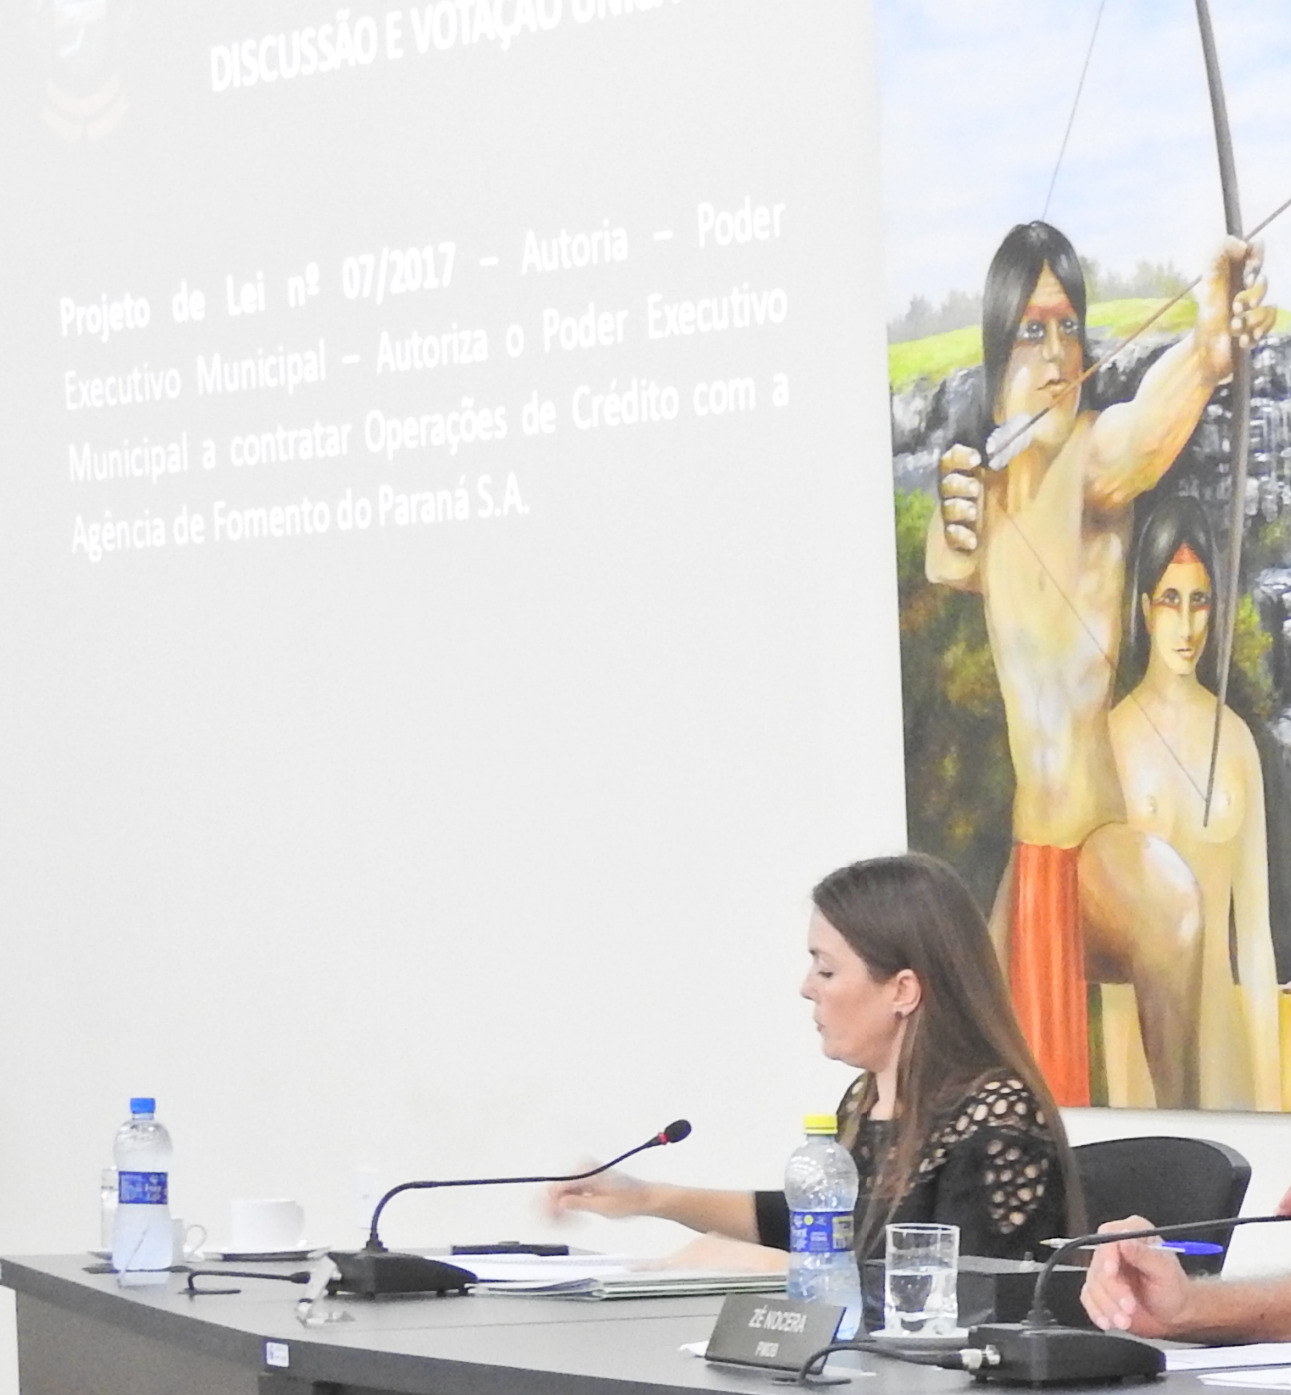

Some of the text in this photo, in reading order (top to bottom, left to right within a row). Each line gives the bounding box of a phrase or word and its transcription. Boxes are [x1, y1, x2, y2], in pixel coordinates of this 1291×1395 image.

[210, 8, 379, 93] DISCUSSÃO
[385, 10, 404, 61] E
[59, 292, 151, 343] Projeto
[171, 280, 206, 323] de
[226, 270, 266, 316] Lei
[341, 241, 457, 306] 07/2017
[521, 218, 629, 275] Autoria
[697, 195, 786, 249] Poder
[64, 362, 182, 411] Executivo
[196, 338, 327, 395] Municipal
[376, 321, 489, 374] Autoriza
[505, 323, 525, 358] o
[542, 301, 629, 353] Poder
[646, 281, 789, 341] Executivo
[68, 372, 790, 484] Municipal a contratar Operações de Crédito com a
[72, 471, 531, 563] Agência de Fomento do Paraná S.A.
[748, 1304, 768, 1329] ZÉ
